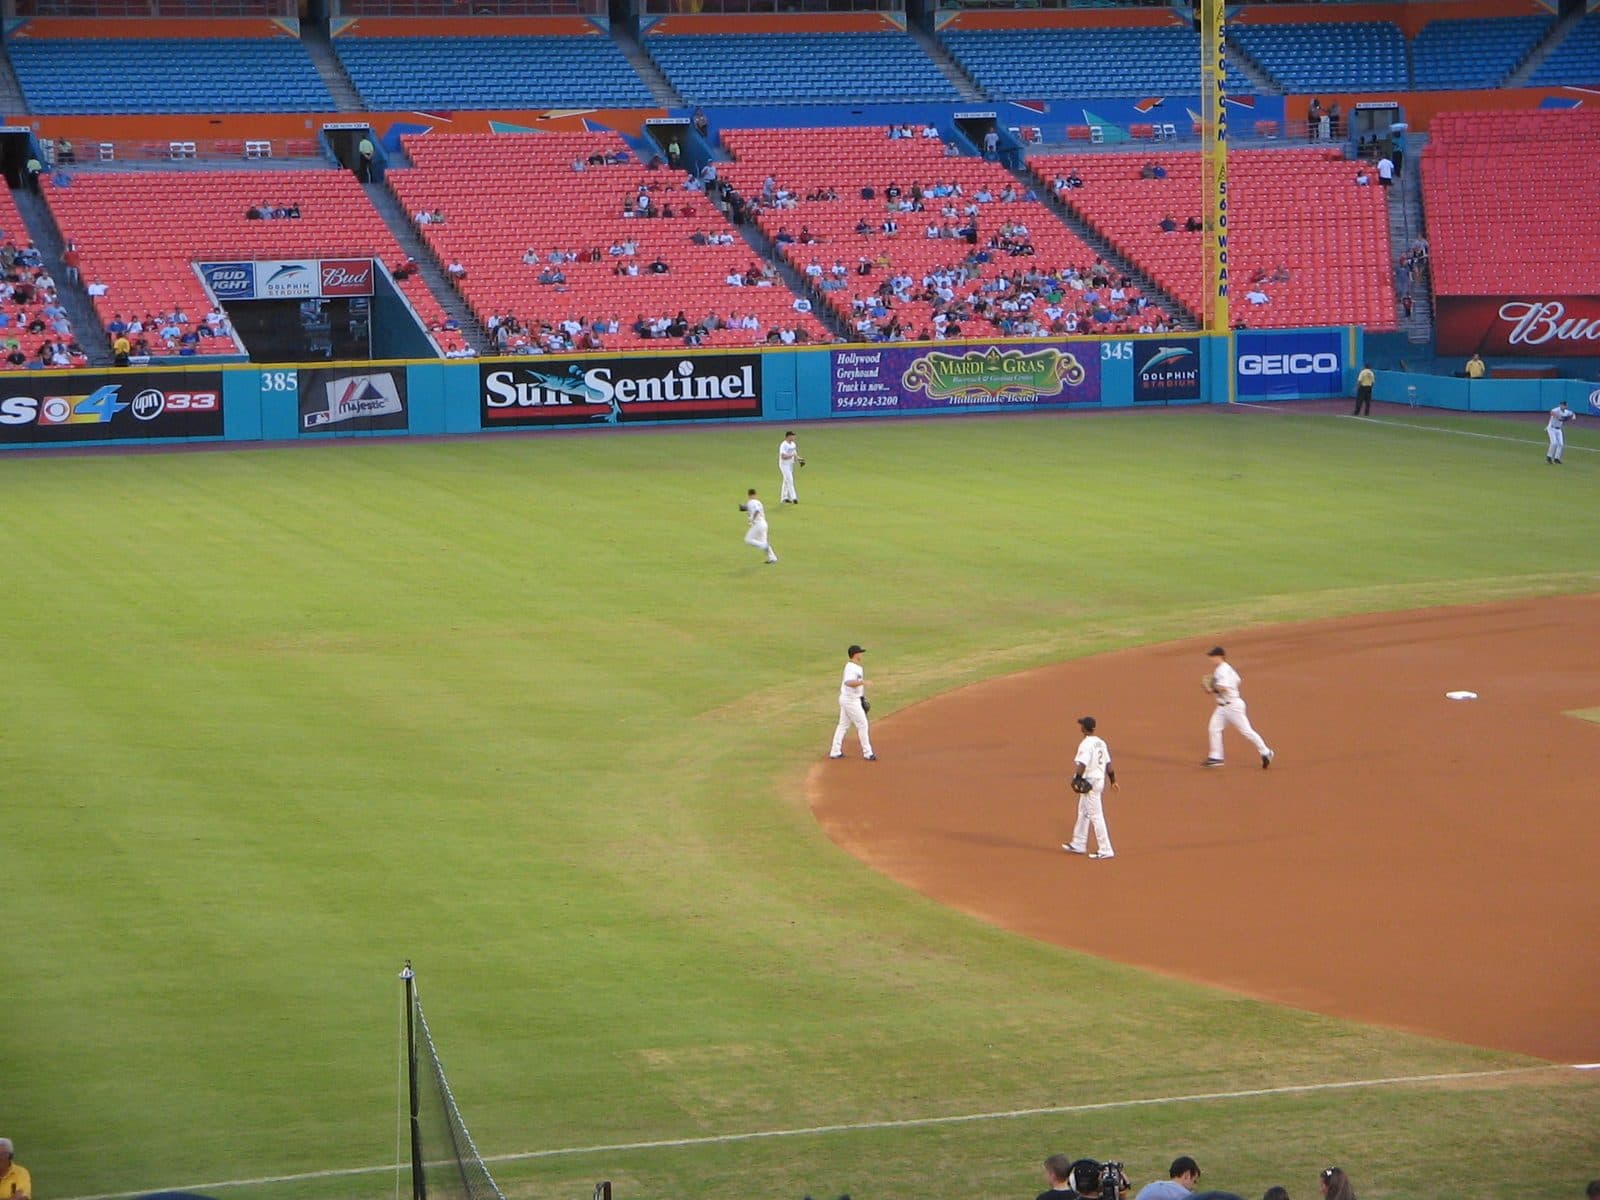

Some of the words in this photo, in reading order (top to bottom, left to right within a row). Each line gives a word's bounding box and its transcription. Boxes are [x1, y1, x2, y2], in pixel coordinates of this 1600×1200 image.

[213, 271, 246, 280] BUD
[322, 267, 369, 287] Bud
[212, 280, 251, 289] IGHT
[1100, 342, 1133, 360] 345
[837, 353, 881, 366] Hollywood
[1238, 353, 1338, 375] GEICO
[940, 361, 984, 375] MARDI
[1003, 358, 1045, 373] GRAS
[837, 367, 879, 380] Greyhound
[1142, 372, 1196, 381] DOLPHIN
[261, 372, 298, 392] 385
[584, 365, 755, 402] Sentinel
[837, 381, 858, 392] Track
[860, 381, 867, 391] is
[1142, 380, 1196, 388] STADIUM
[166, 393, 216, 409] 33
[837, 396, 898, 407] 954-924-3200
